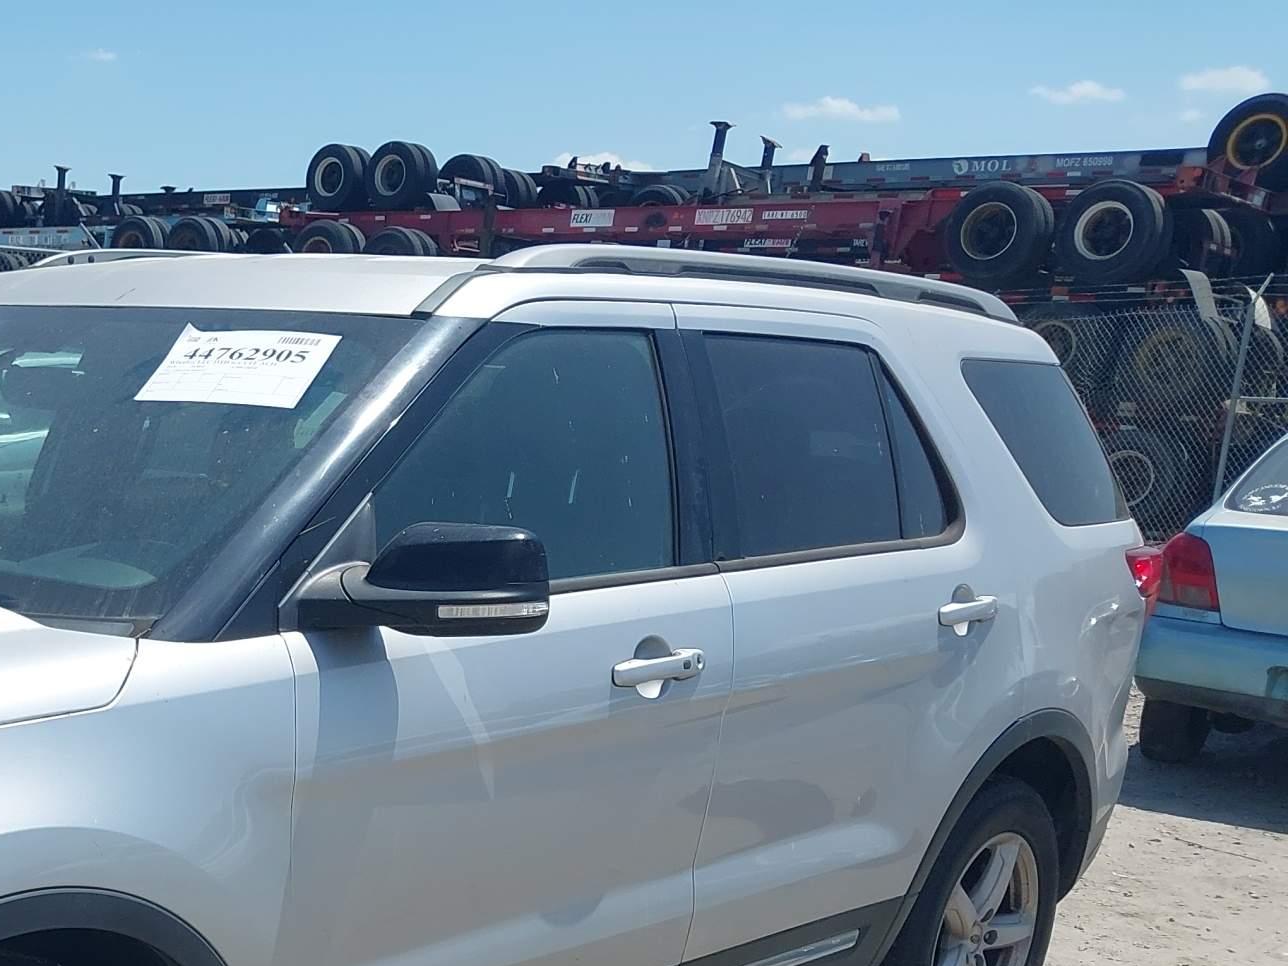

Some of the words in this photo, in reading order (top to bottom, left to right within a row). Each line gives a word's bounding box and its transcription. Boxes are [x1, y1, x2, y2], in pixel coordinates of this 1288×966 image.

[971, 159, 1012, 172] MOL
[572, 212, 593, 224] FLEXI
[184, 347, 312, 364] 44762905
